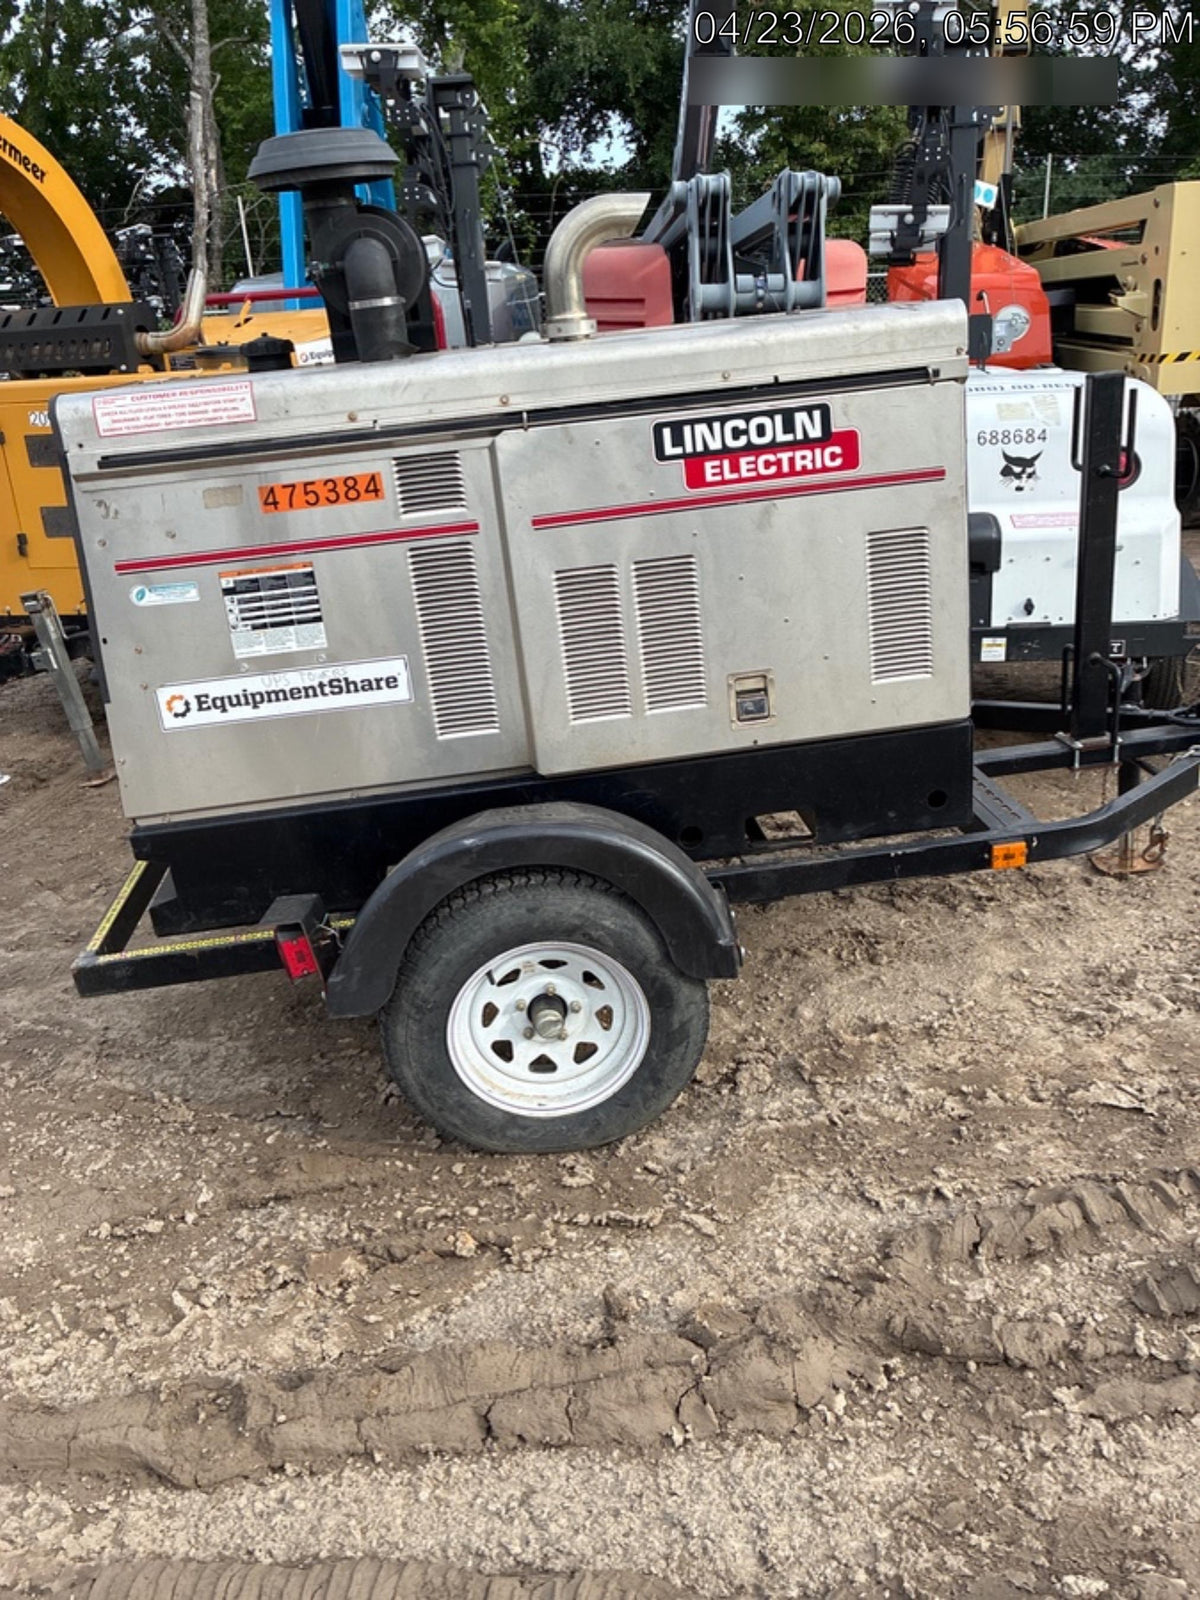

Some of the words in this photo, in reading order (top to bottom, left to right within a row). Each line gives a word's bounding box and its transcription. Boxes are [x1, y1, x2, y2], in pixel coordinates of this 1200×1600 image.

[0, 134, 46, 184] rmeer
[662, 409, 823, 456] LINCOLN
[977, 428, 1048, 446] 688684
[704, 446, 843, 483] ELECTRIC
[263, 474, 380, 510] 475384
[194, 674, 399, 713] EquipmentShare
